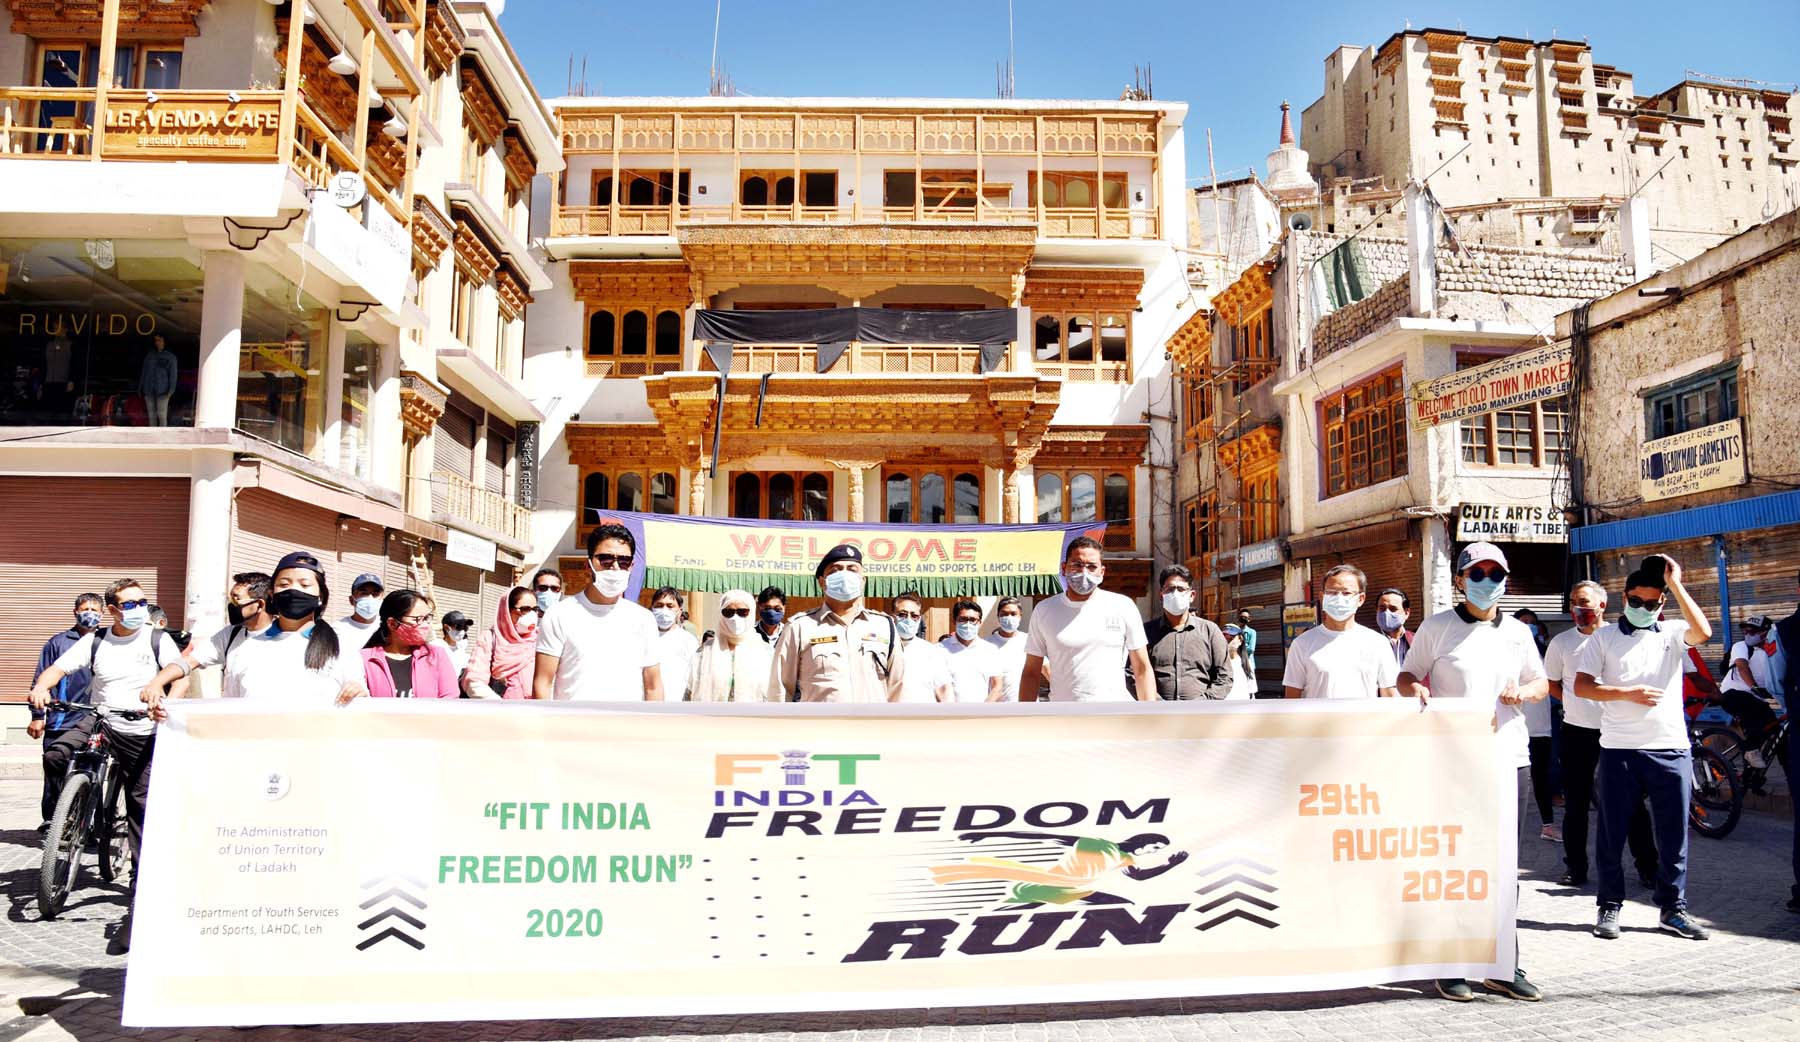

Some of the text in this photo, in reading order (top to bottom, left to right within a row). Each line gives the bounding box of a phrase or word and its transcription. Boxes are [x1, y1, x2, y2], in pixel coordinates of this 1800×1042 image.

[223, 110, 279, 129] CAFE
[137, 135, 247, 148] specialty coffee shop
[19, 313, 156, 336] RUVIDO
[1417, 393, 1456, 417] WELCOME
[1458, 390, 1467, 407] TO
[1470, 385, 1487, 404] OLD
[1490, 375, 1519, 398] TOWN
[1523, 361, 1573, 389] MARKET
[1440, 407, 1466, 420] PALACE
[1467, 403, 1487, 414] ROAD
[1699, 434, 1740, 466] GARMENTS
[1462, 504, 1559, 520] CUTE ARTS &
[726, 558, 804, 571] DEPARTMENT
[863, 562, 911, 573] SERVICES
[916, 563, 937, 573] AND
[983, 562, 1014, 572] LAHDC
[1018, 562, 1036, 572] LEH
[714, 790, 880, 807] INDIA
[1299, 783, 1380, 816] 29th
[561, 802, 652, 830] INDIA
[704, 797, 1171, 838] FREEDOM
[216, 826, 328, 837] The Administration
[218, 843, 324, 856] of Union Territory
[1332, 825, 1463, 862] AUGUST
[239, 861, 297, 872] of Ladakh
[438, 855, 597, 883] FREEDOM
[1402, 869, 1489, 902] 2020
[187, 906, 340, 919] Department of Youth Services
[525, 908, 603, 937] 2020
[200, 925, 219, 935] and
[222, 924, 257, 936] Sports,
[304, 923, 323, 934] Leh
[840, 903, 1192, 963] RUN
